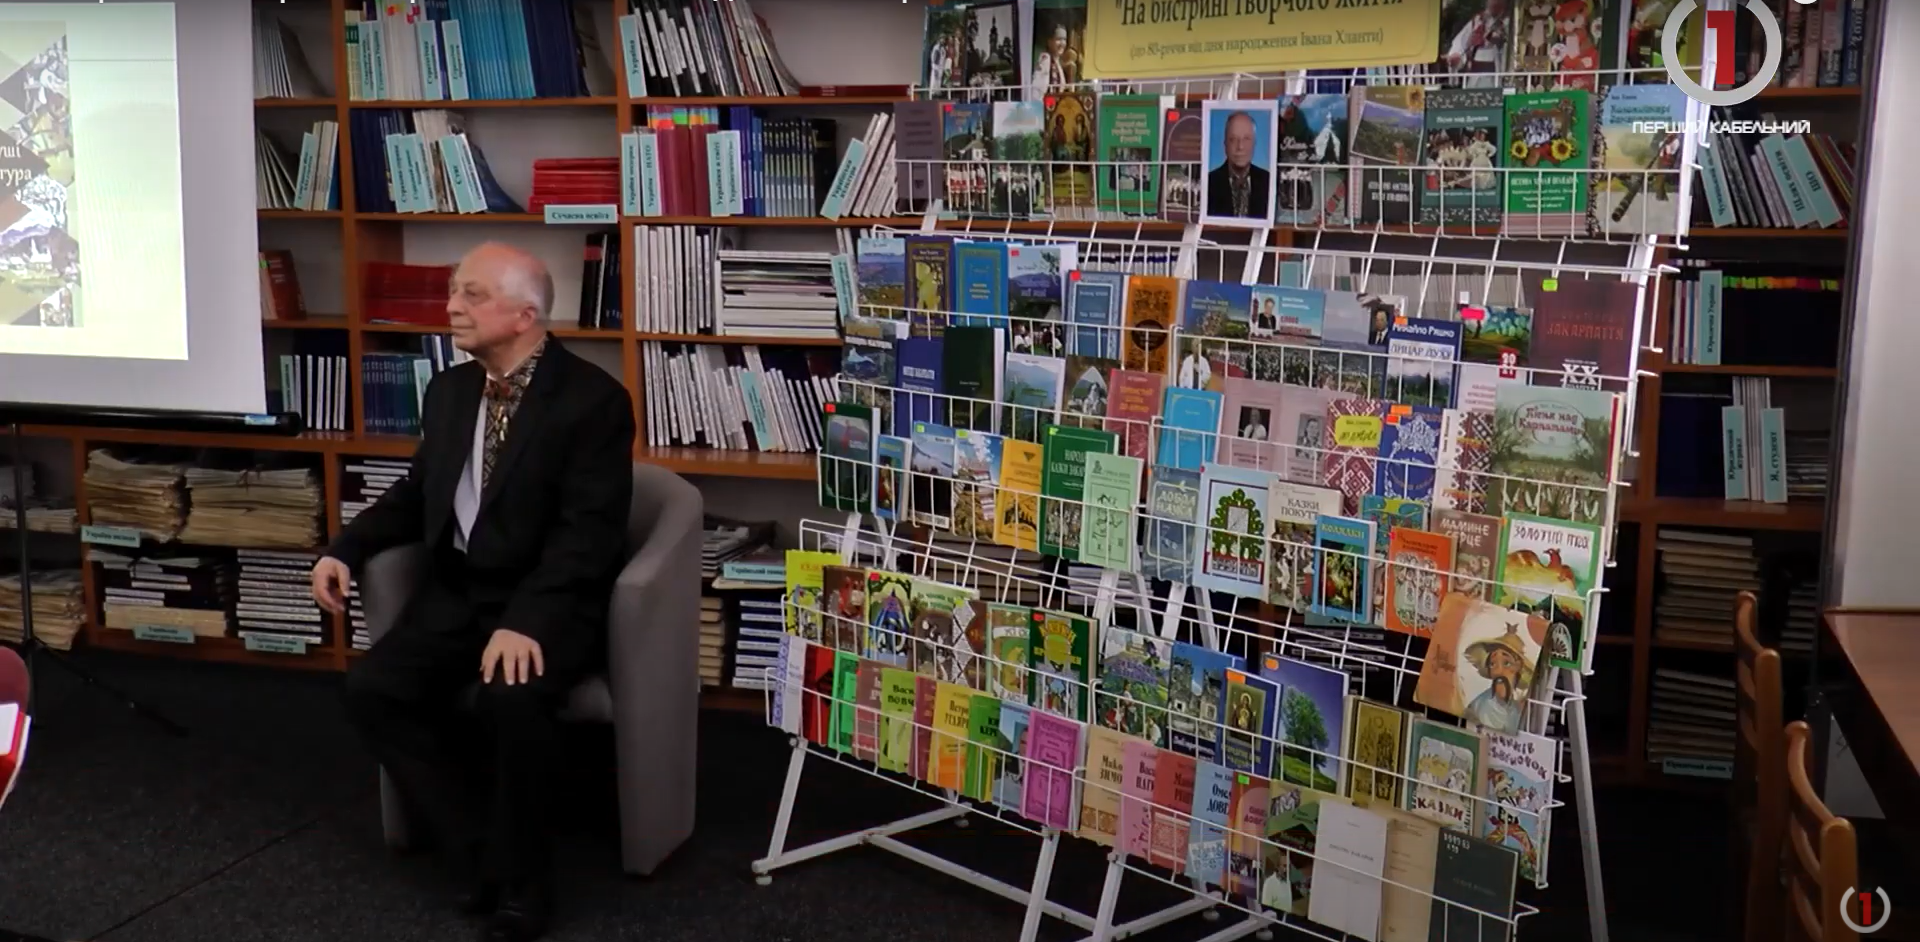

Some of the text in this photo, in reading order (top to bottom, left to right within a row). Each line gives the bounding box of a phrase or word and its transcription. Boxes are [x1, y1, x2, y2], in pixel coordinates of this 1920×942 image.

[1226, 36, 1297, 53] народження
[1300, 32, 1332, 46] Івана
[1335, 28, 1384, 46] Хланти)
[629, 39, 641, 75] Україна
[0, 145, 21, 158] уші
[0, 168, 32, 187] тура
[551, 211, 610, 221] Сучасна освіта
[1547, 323, 1624, 340] ЗАКАРПАТТЯ
[1065, 449, 1086, 462] НАРОД
[1770, 431, 1780, 469] студент
[1280, 506, 1319, 519] ПОКУТТ
[1287, 498, 1319, 511] КАЗКИ
[1440, 516, 1490, 536] МАМИНЕ
[1444, 530, 1483, 548] СЕРЦЕ
[1513, 525, 1563, 545] ЗОЛОТИЙ
[893, 684, 914, 695] Васи
[888, 695, 914, 707] ВОВЧ
[945, 713, 968, 729] УГЛЯР
[1102, 755, 1123, 772] Мико
[1100, 768, 1123, 785] ЗИМО
[1416, 796, 1465, 822] КАЗКИ
